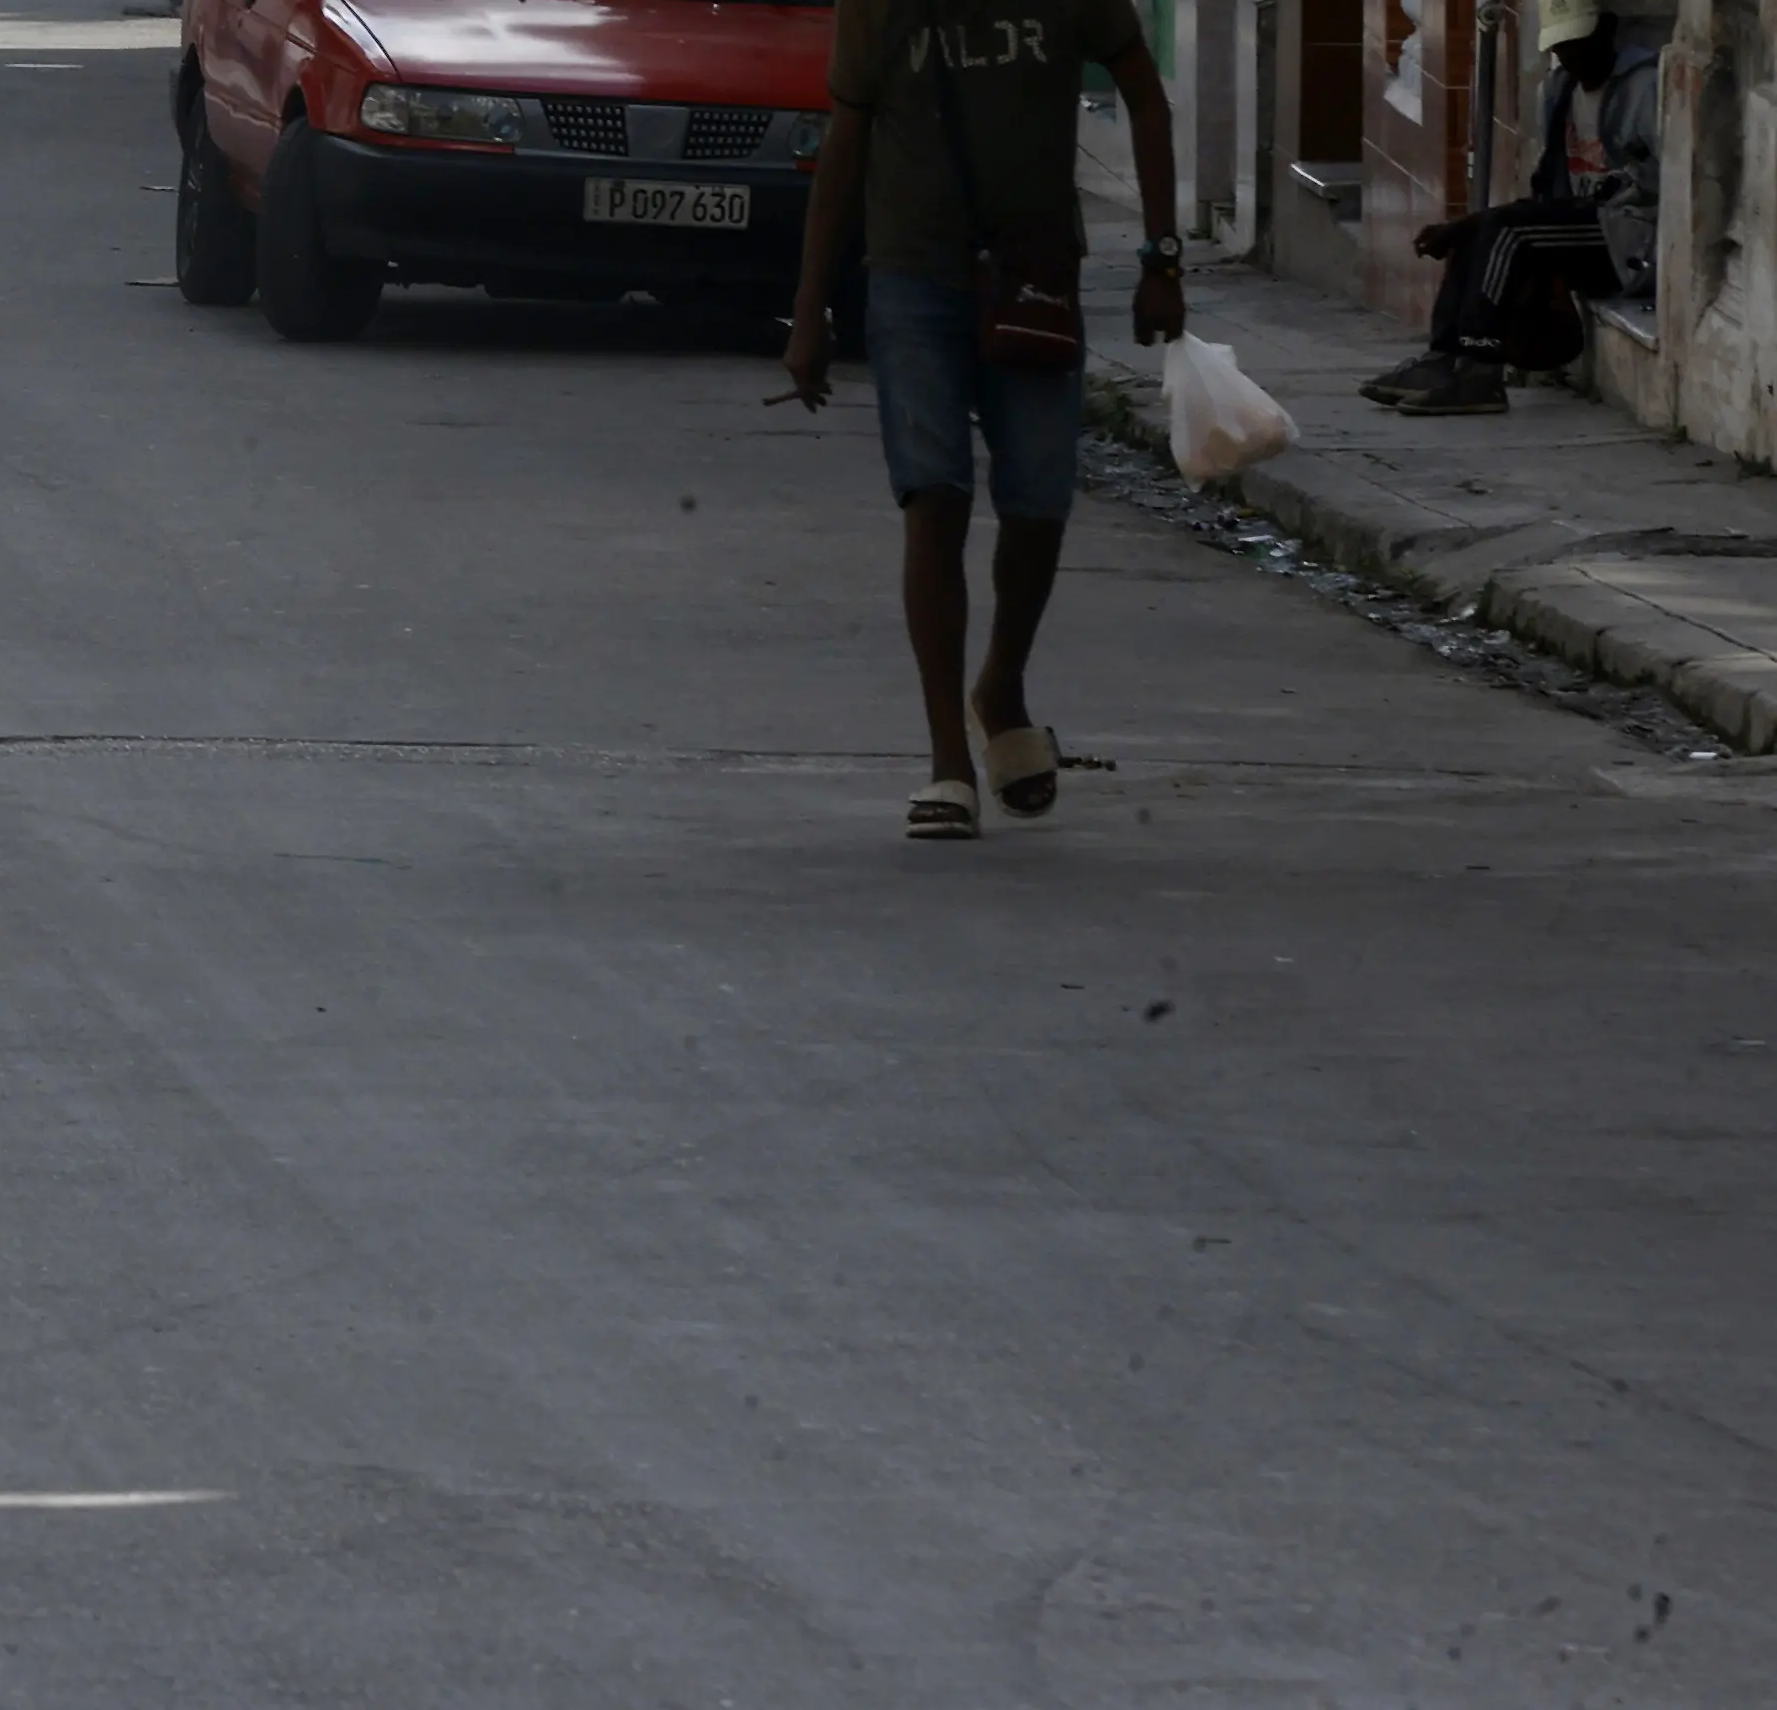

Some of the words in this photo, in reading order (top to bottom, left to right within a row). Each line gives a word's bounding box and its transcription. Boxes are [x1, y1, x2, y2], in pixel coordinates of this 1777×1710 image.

[609, 186, 626, 218] P
[631, 188, 685, 221] 097
[692, 191, 745, 224] 630
